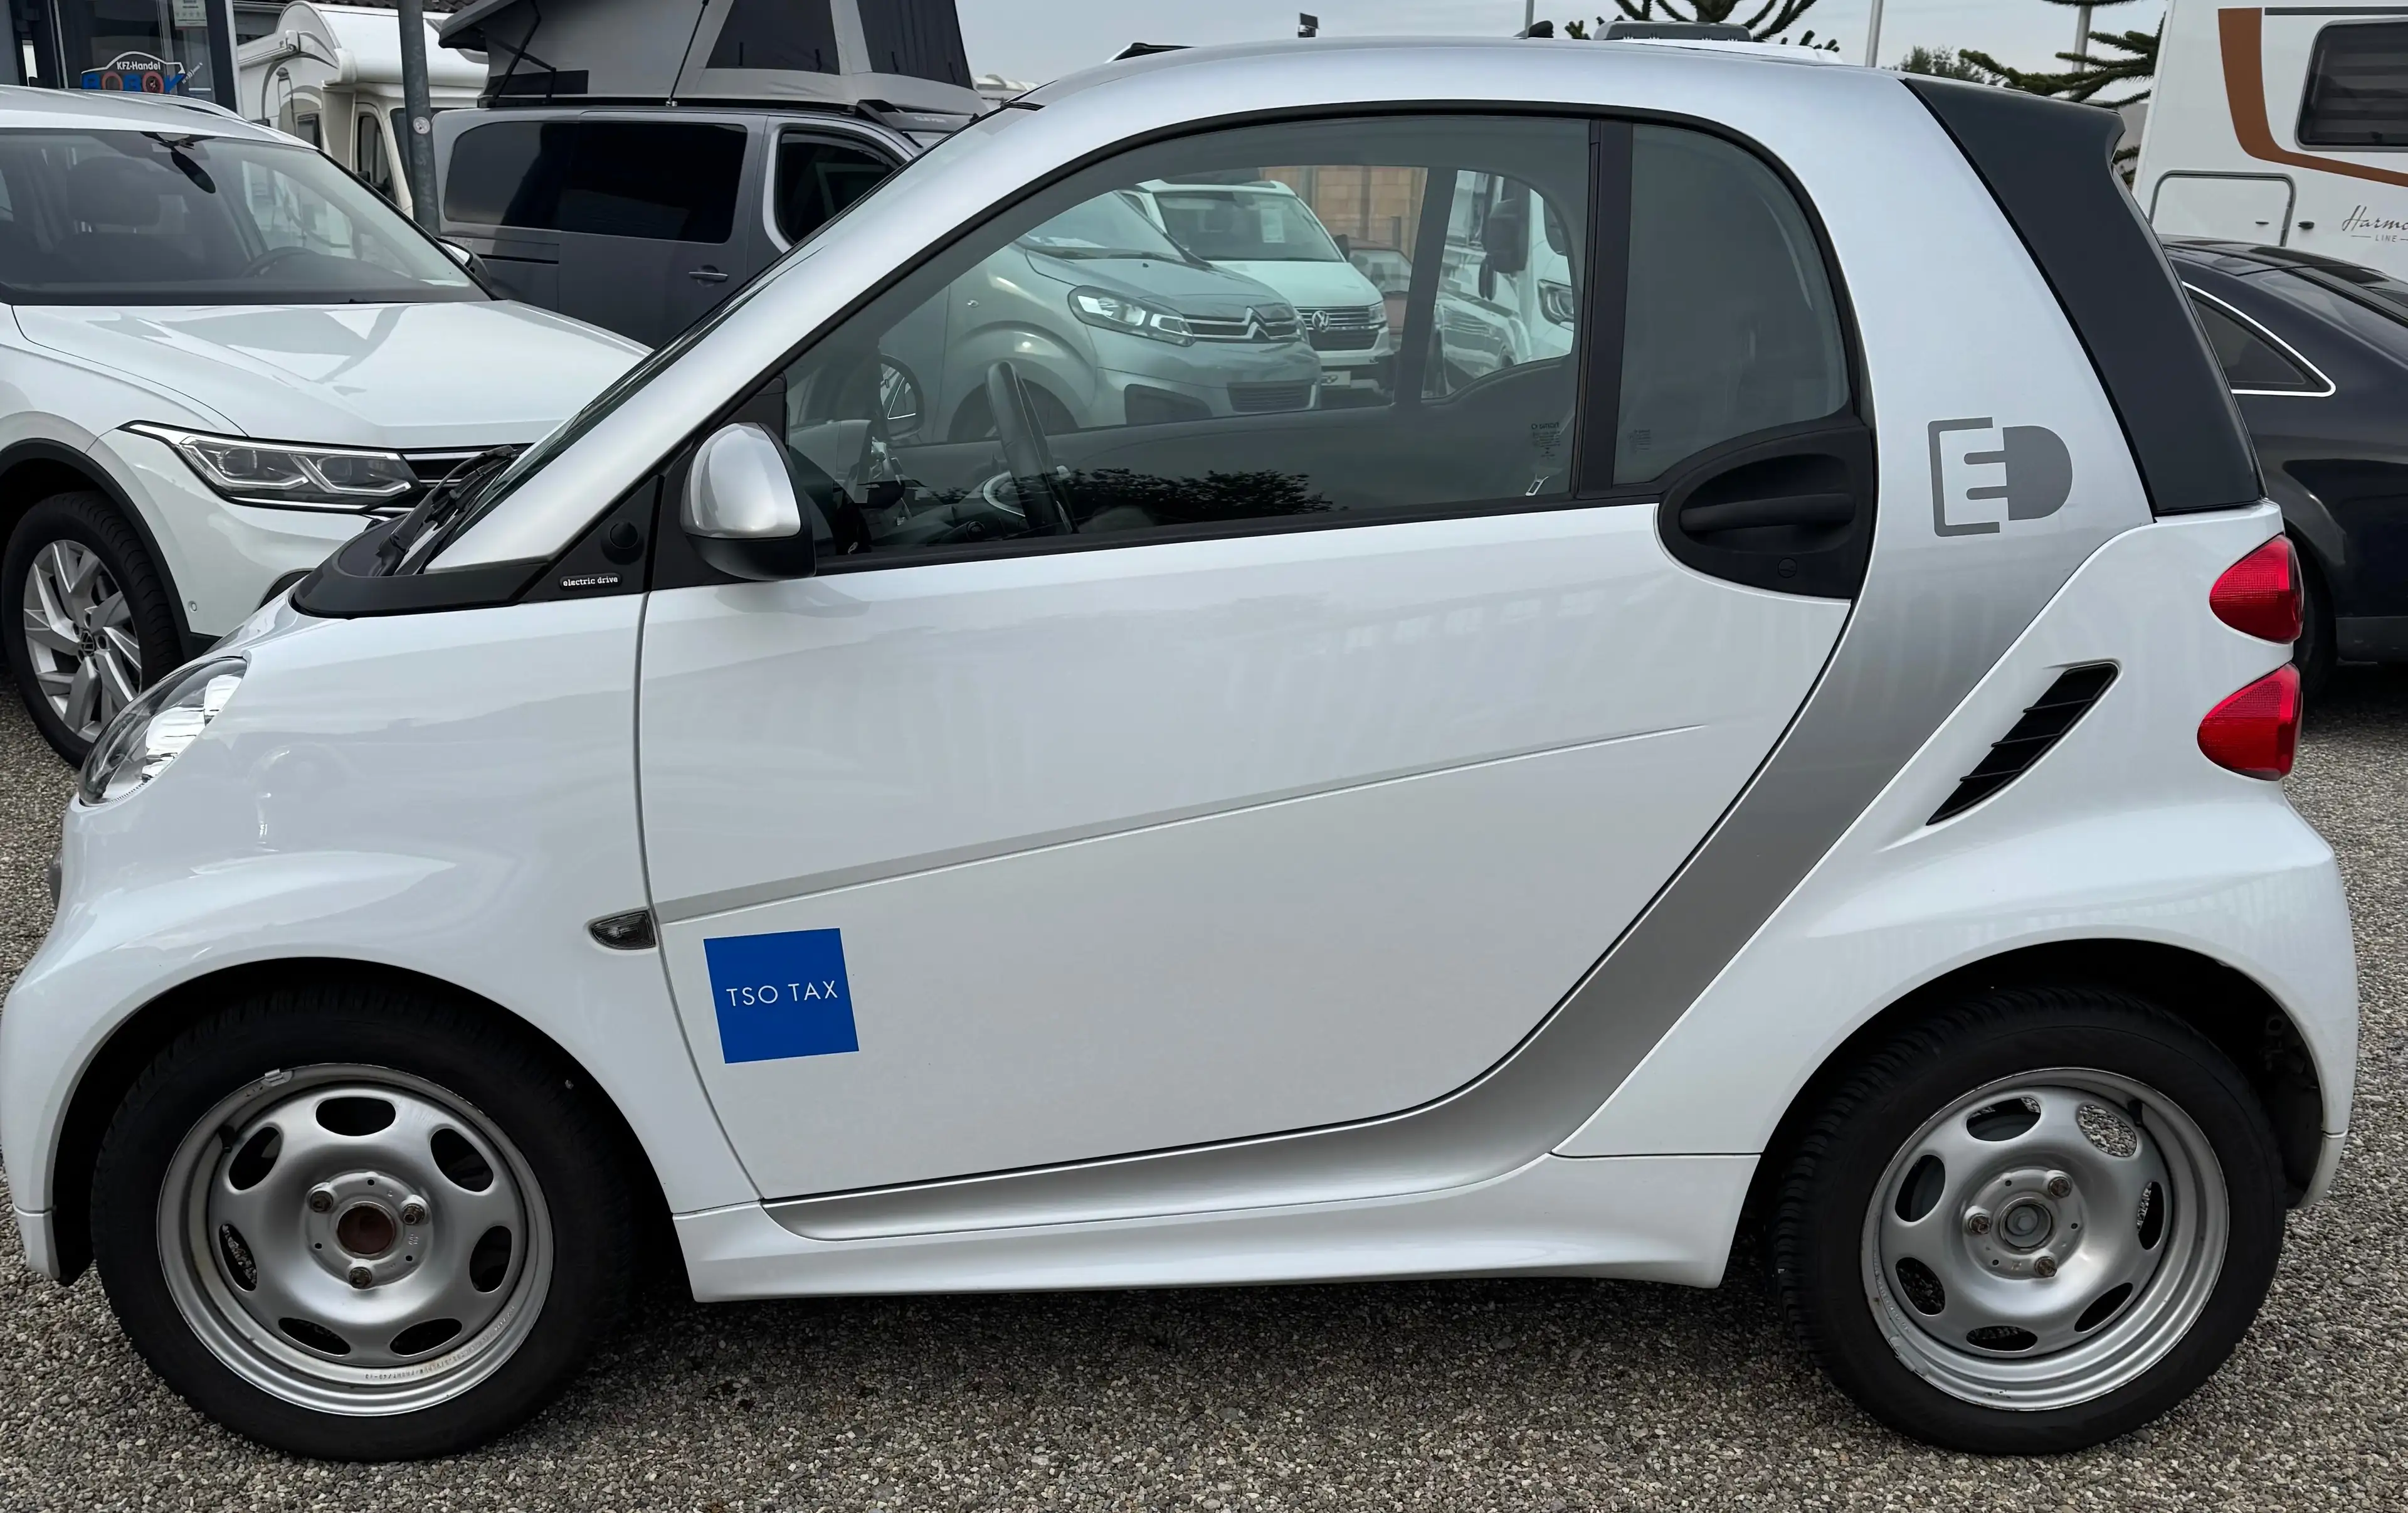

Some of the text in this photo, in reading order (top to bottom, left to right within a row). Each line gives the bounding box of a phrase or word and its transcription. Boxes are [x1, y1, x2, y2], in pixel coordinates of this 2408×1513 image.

[117, 61, 161, 71] KFZ-Handel
[2375, 234, 2398, 242] LINE
[562, 576, 618, 587] electric drive
[726, 980, 838, 1007] TSO TAX
